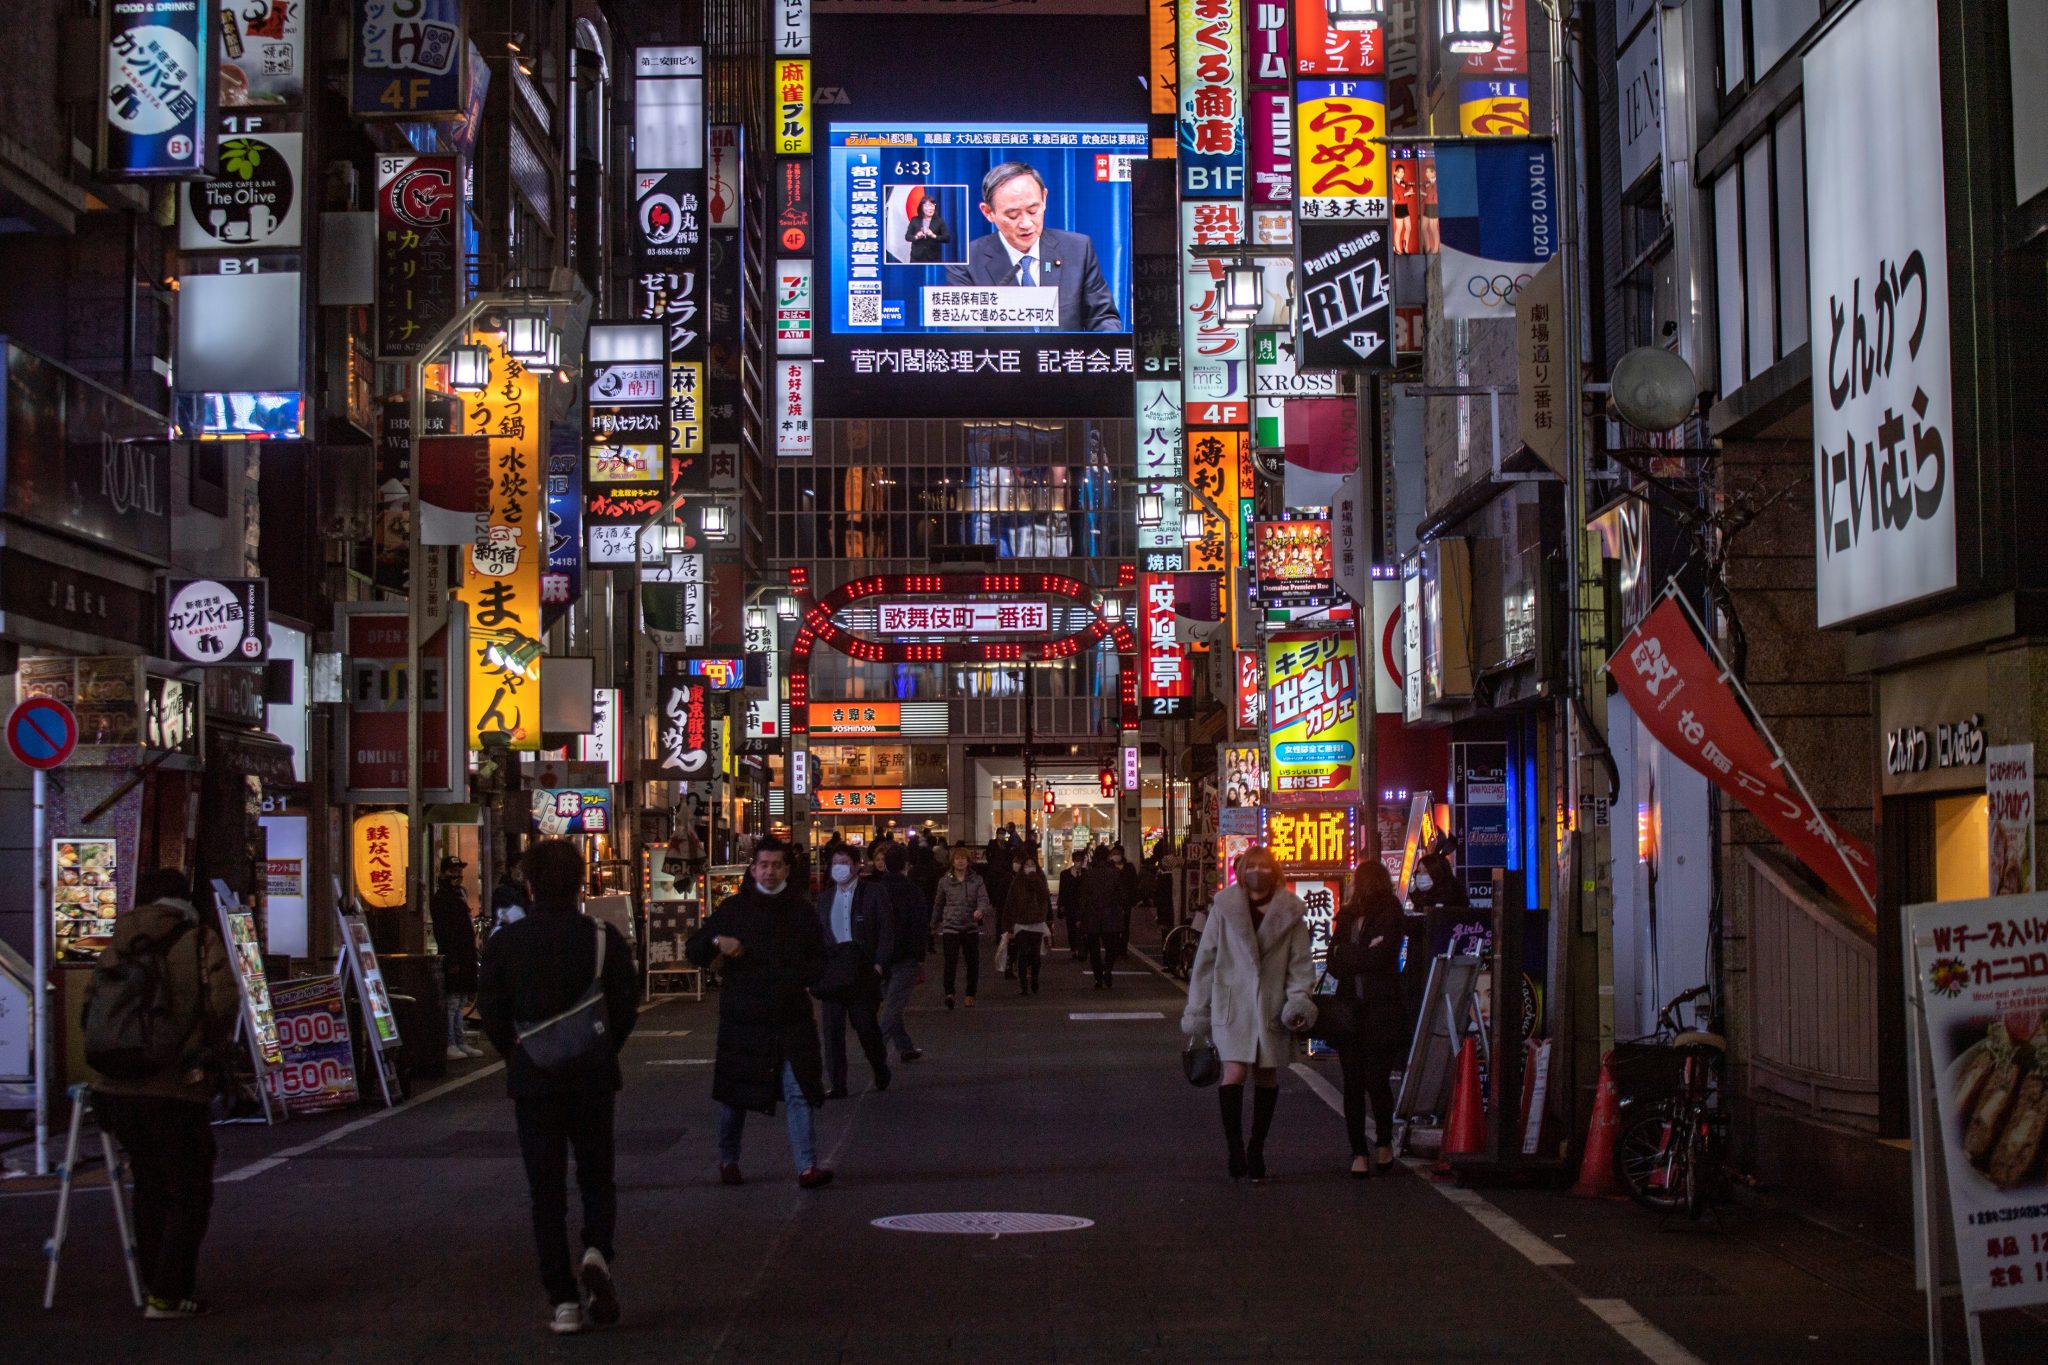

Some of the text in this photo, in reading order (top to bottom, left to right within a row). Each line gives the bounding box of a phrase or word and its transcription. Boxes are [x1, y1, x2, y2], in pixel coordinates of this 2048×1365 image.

[115, 4, 145, 13] FOOD
[155, 2, 196, 12] DRINKS
[148, 40, 189, 81] 新宿酒場
[641, 57, 697, 66] 第二安田ビル
[1300, 60, 1315, 71] 2F
[111, 32, 196, 122] カンパイ屋
[120, 66, 161, 109] KANPAIYA
[380, 79, 431, 110] 4F
[1329, 82, 1356, 96] 1F
[781, 63, 804, 137] 麻雀ブル
[223, 116, 263, 133] 1F
[171, 140, 191, 154] B1
[784, 140, 801, 151] 6F
[849, 133, 914, 144] デパート1都3県
[1310, 103, 1374, 195] らーめん
[382, 159, 403, 173] 3F
[894, 162, 931, 175] 6:33
[206, 181, 233, 189] DINING
[640, 179, 655, 188] 4F
[1188, 167, 1243, 190] B1F
[206, 188, 277, 205] The Olive
[1529, 153, 1549, 256] TOKYO 2020
[1302, 199, 1384, 218] 博多天神
[676, 232, 699, 244] 酒場
[787, 234, 800, 244] 4F
[647, 247, 690, 256] 03-6886-6759
[1303, 230, 1380, 277] Party Space
[219, 258, 260, 274] B1
[400, 230, 420, 342] カリーナ
[932, 292, 998, 305] 核兵器保有国を
[1306, 260, 1384, 337] RIZ
[669, 272, 698, 352] リラク
[783, 311, 805, 319] たばこ
[931, 308, 1054, 322] 巻き込んで進めること不可欠
[1830, 250, 1927, 412] とんかつ
[1260, 339, 1272, 350] 肉
[1354, 336, 1375, 347] B1
[851, 349, 1133, 373] 菅内閣総理大臣 記者会見
[1144, 357, 1180, 372] 3F
[1531, 304, 1552, 430] 劇場通り一番街
[621, 371, 659, 380] さつま居酒屋
[1258, 374, 1333, 391] XROSS
[628, 381, 656, 396] 酔月
[671, 366, 697, 422] 麻雀
[788, 366, 802, 415] お好み焼
[1203, 406, 1237, 423] 4F
[592, 415, 661, 432] 日本人セラピスト
[782, 421, 808, 431] 本陣
[671, 427, 698, 448] 2F
[1240, 438, 1254, 490] 炭火串焼
[101, 432, 163, 516] ROYAL
[1821, 385, 1946, 562] にいむら
[500, 447, 528, 523] 水炊き
[593, 527, 632, 538] 居酒屋
[1155, 536, 1173, 544] 3F
[1341, 500, 1354, 577] 劇場通り一番街
[475, 543, 516, 566] 新宿
[1147, 553, 1182, 571] 焼肉
[489, 563, 503, 574] の
[185, 597, 220, 609] 新宿酒場
[169, 602, 244, 630] カンパイ屋
[885, 607, 1044, 629] 歌舞伎町一番街
[189, 624, 227, 635] KANPAIYA
[368, 630, 401, 642] OPEN
[245, 642, 258, 651] B1
[1275, 634, 1338, 675] キラリ
[1273, 658, 1349, 722] 出会い
[1153, 697, 1179, 713] 2F
[1305, 699, 1352, 737] カフェ
[1888, 713, 1985, 776] とんかつ にいむら
[358, 750, 403, 765] ONLINE
[878, 753, 904, 766] 客席
[1127, 750, 1135, 787] 劇場通り
[1278, 776, 1330, 788] 受付3F
[262, 796, 287, 811] B1
[583, 796, 606, 805] フリー
[1270, 811, 1343, 860] 案内所
